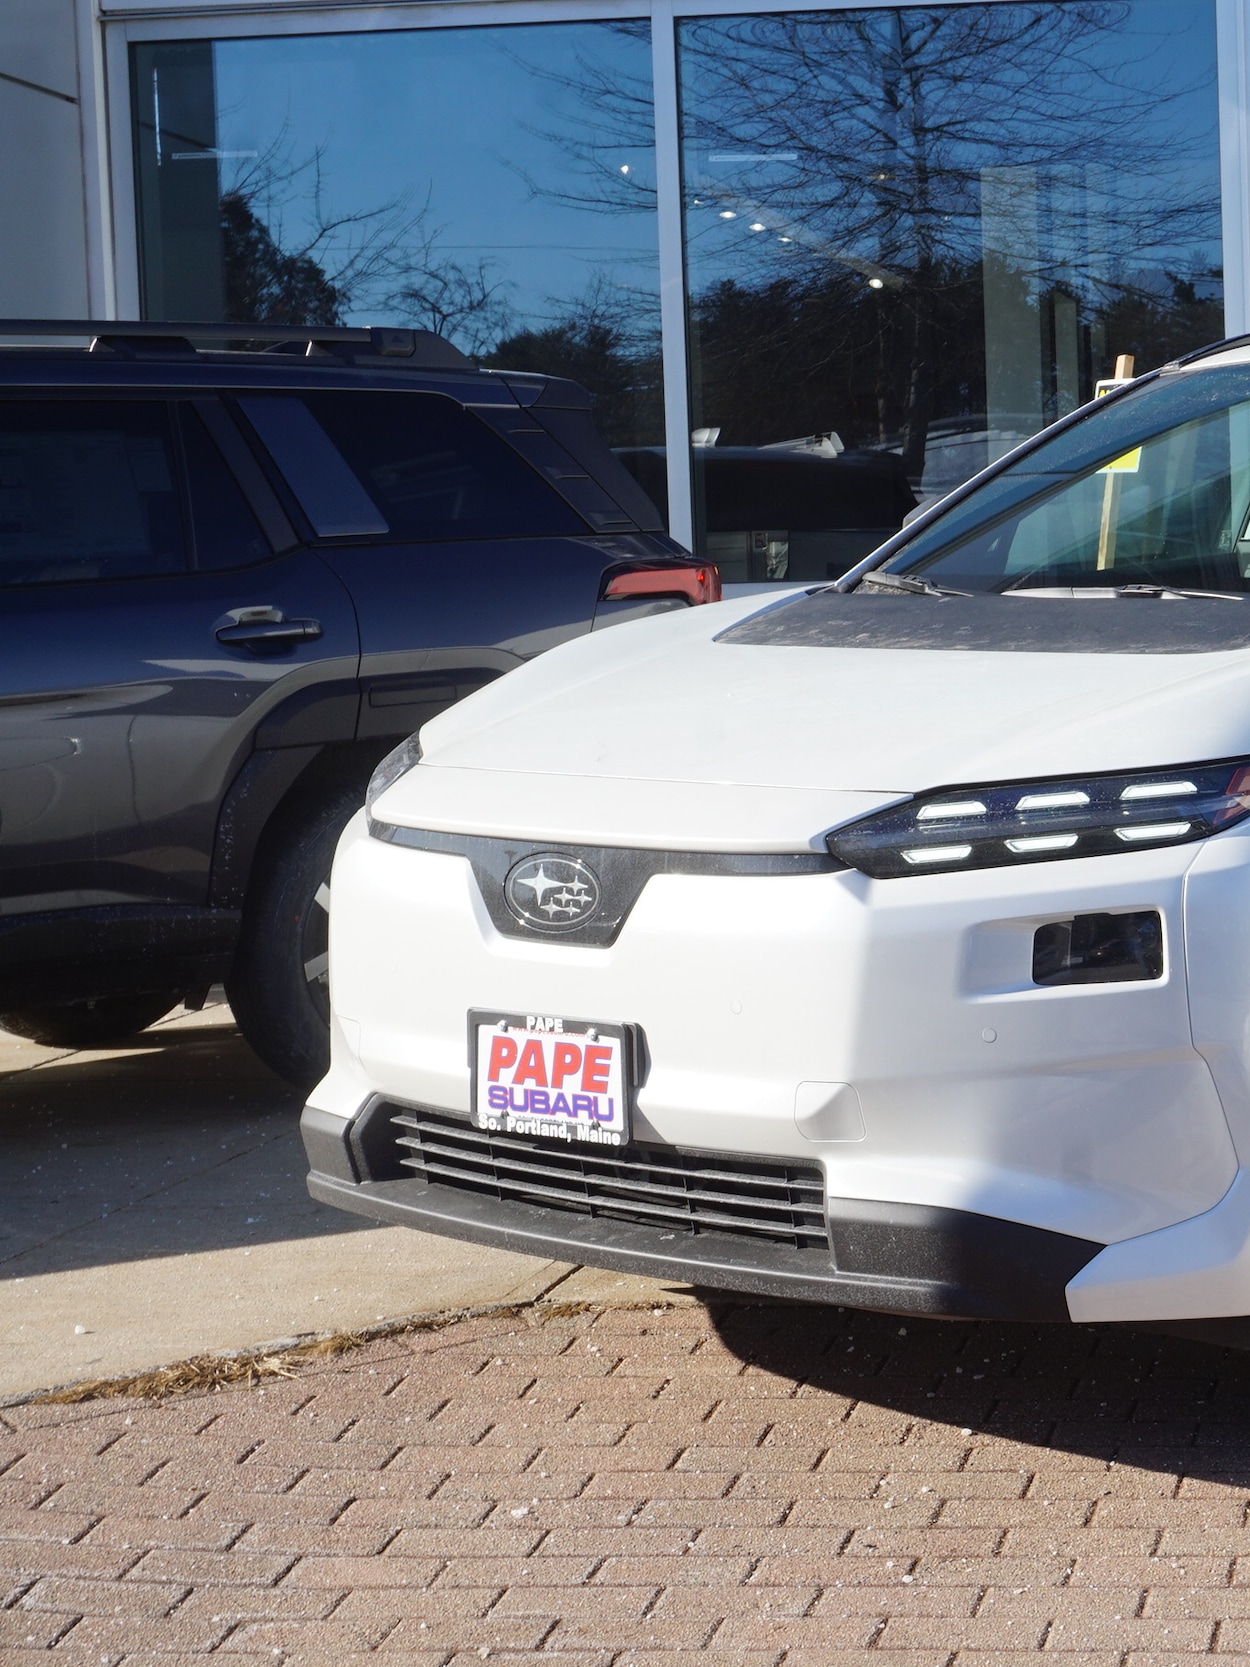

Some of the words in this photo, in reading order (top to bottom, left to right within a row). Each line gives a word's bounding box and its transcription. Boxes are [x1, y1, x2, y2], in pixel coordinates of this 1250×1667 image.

[526, 1015, 564, 1033] PAPE
[487, 1035, 613, 1094] PAPE
[487, 1085, 614, 1122] SUBARU
[478, 1113, 502, 1131] So.
[506, 1116, 572, 1143] Portland,
[577, 1125, 621, 1146] Maine
